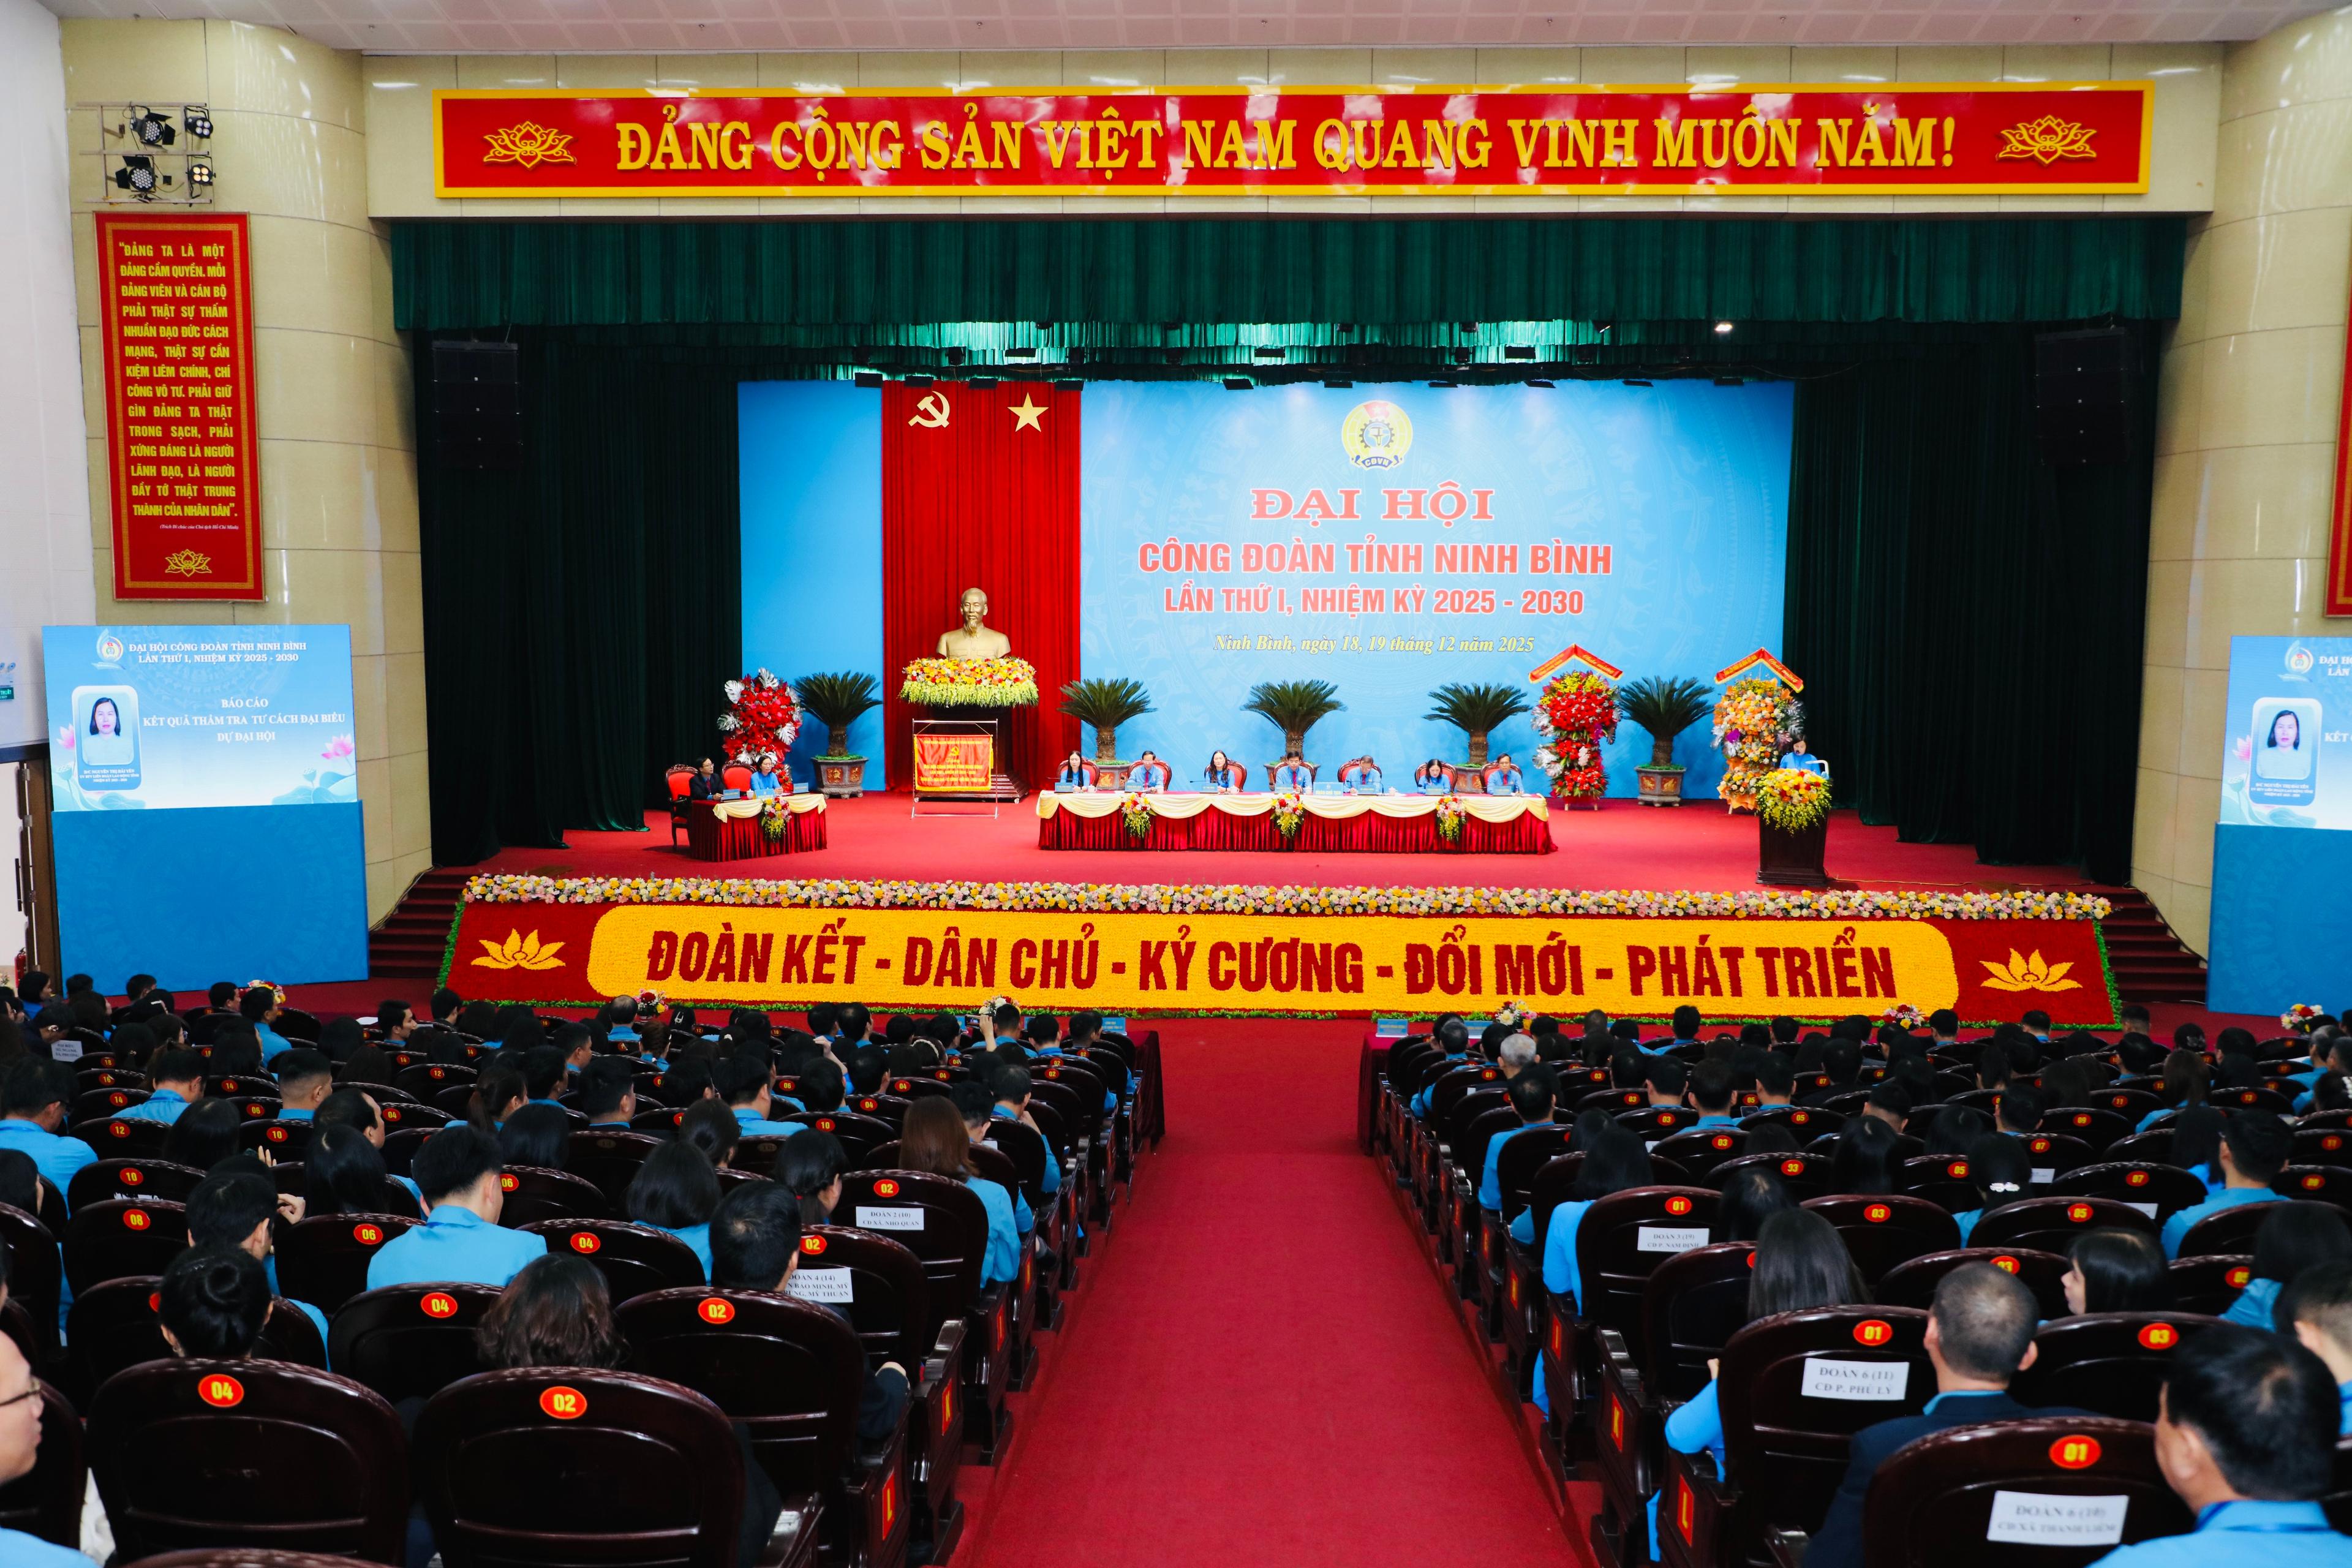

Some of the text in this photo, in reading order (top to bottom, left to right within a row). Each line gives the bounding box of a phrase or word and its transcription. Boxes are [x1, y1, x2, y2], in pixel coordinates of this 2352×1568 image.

[616, 102, 1956, 181] ĐẢNG CỘNG SẢN VIỆT NAM QUANG VINH MUÔN NĂM!
[119, 241, 224, 258] “ĐẢNG TA LÀ MỘT
[120, 262, 225, 278] ĐẢNG CẦM QUYỀN. MỖI
[121, 282, 227, 300] ĐẢNG VIÊN VÀ CÁN BỘ
[123, 302, 228, 319] PHẢI THẬT SỰ THẤM
[124, 322, 228, 339] NHUẦN ĐẠO ĐỨC CÁCH
[125, 343, 230, 360] MẠNG, THẬT SỰ CẦN
[126, 364, 230, 379] KIỆM LIÊM CHÍNH, CHÍ
[127, 383, 232, 398] CÔNG VÔ TƯ. PHẢI GIỮ
[128, 403, 232, 420] GÌN ĐẢNG TA THẬT
[129, 423, 233, 440] TRONG SẠCH, PHẢI
[130, 443, 234, 458] XỨNG ĐÁNG LÀ NGƯỜI
[130, 464, 235, 478] LÃNH ĐẠO, LÀ NGƯỜI
[132, 482, 236, 499] ĐẦY TỚ THẬT TRUNG
[133, 502, 238, 516] THÀNH CỦA NHÂN DÂN”.
[1250, 479, 1496, 528] ĐẠI HỘI
[1139, 533, 1612, 576] CÔNG ĐOÀN TỈNH NINH BÌNH
[1164, 581, 1584, 619] LẦN THỨ I, NHIỆM KỲ 2025 2030
[129, 643, 146, 653] ĐẠI
[150, 643, 167, 653] HỘI
[170, 643, 197, 651] CÔNG
[201, 642, 228, 651] ĐOÀN
[232, 641, 254, 650] TỈNH
[283, 641, 306, 650] BÌNH
[1214, 635, 1535, 655] Ninh Bình, ngày 18, 19 tháng 12 năm 2025
[138, 654, 158, 663] LẦN
[161, 653, 182, 663] THỨ
[185, 655, 191, 663] I,
[194, 654, 226, 665] NHIỆM
[228, 654, 243, 662] KỲ
[221, 697, 268, 708] BÁO CÁO
[143, 712, 345, 727] KẾT QUẢ THẨM TRA TƯ CÁCH ĐẠI BIỂU
[217, 731, 276, 743] DỰ ĐẠI HỘI
[648, 918, 1896, 998] ĐOÀN KẾT DÂN CHỦ KỶ CƯƠNG ĐỔI MỚI PHÁT TRIỂN
[115, 1126, 124, 1134] 12
[126, 1172, 137, 1182] 10
[881, 1184, 894, 1193] 02
[1672, 1200, 1684, 1212] 01
[2074, 1208, 2087, 1218] 05
[130, 1214, 143, 1226] 08
[362, 1229, 375, 1240] 06
[578, 1237, 592, 1248] 04
[431, 1299, 449, 1313] 04
[1864, 1326, 1882, 1340] 01
[211, 1382, 233, 1400] 04
[554, 1394, 576, 1412] 02
